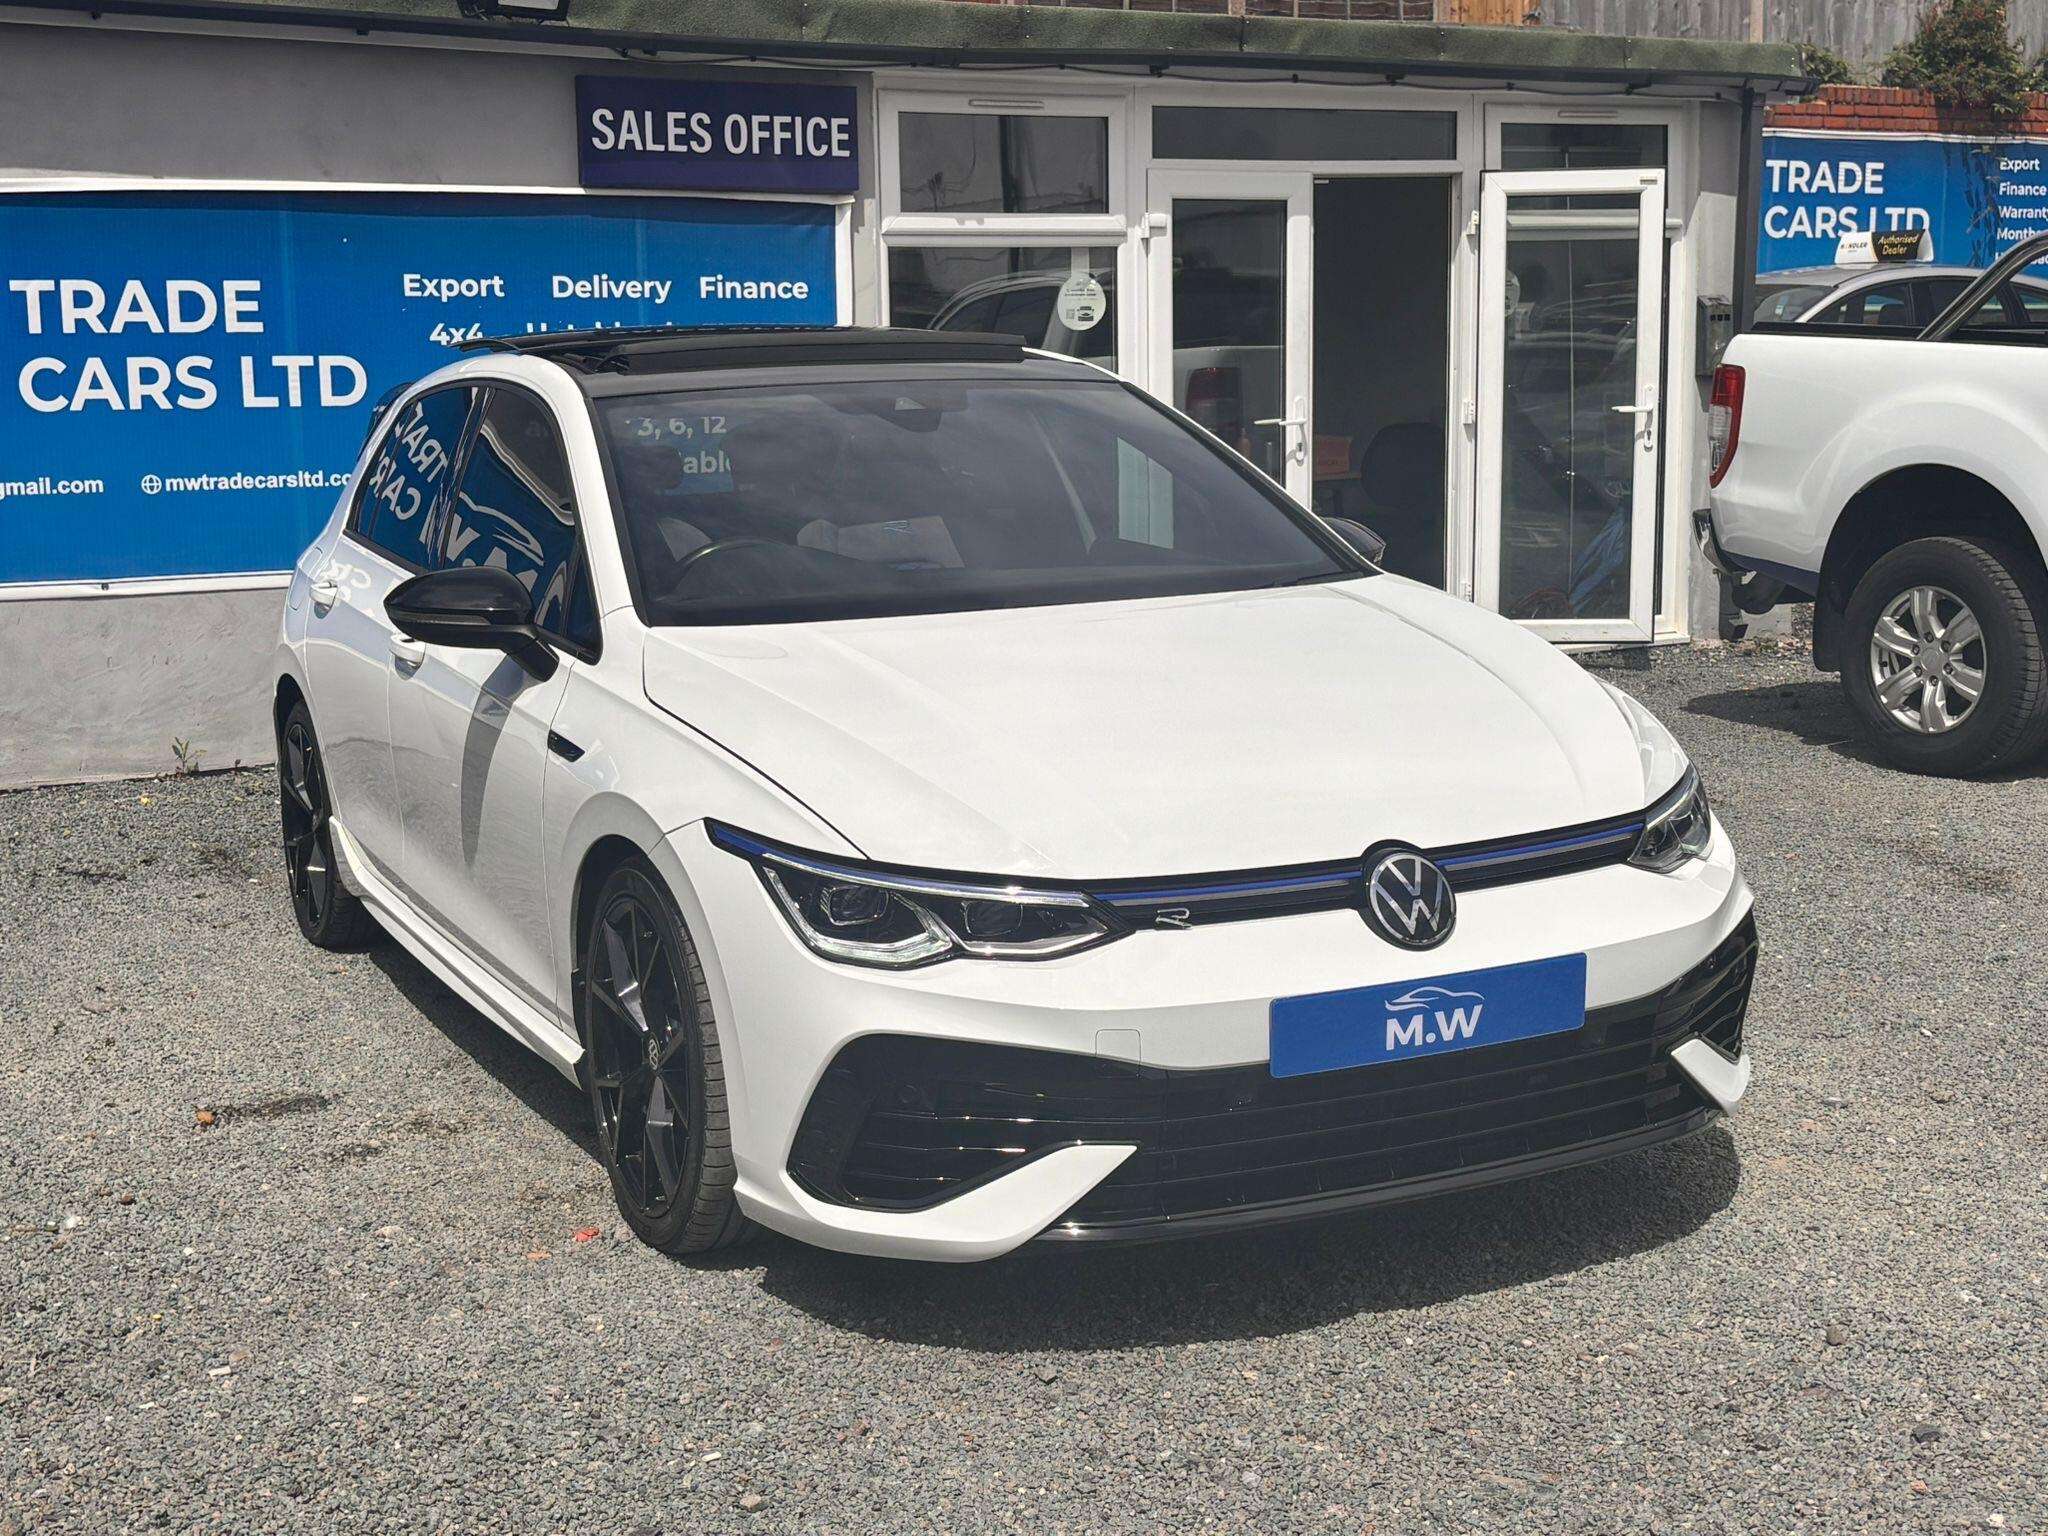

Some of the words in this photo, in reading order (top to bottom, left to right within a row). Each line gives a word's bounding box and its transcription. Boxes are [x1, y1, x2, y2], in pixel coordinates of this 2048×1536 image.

[591, 108, 713, 154] SALES
[723, 113, 850, 157] OFFICE
[1765, 159, 1885, 195] TRADE
[1999, 157, 2041, 173] Export
[1999, 182, 2048, 197] Finance
[1763, 205, 1859, 239] CARS
[1996, 226, 2042, 241] Month
[1882, 245, 1908, 256] Dealer
[402, 273, 506, 303] Export
[551, 274, 673, 305] Delivery
[699, 274, 810, 300] Finance
[8, 278, 264, 335] TRADE
[429, 322, 484, 347] 4x4
[18, 355, 218, 413] CARS
[240, 355, 368, 408] LTD
[703, 415, 728, 435] 12
[1386, 1004, 1484, 1051] M.W
